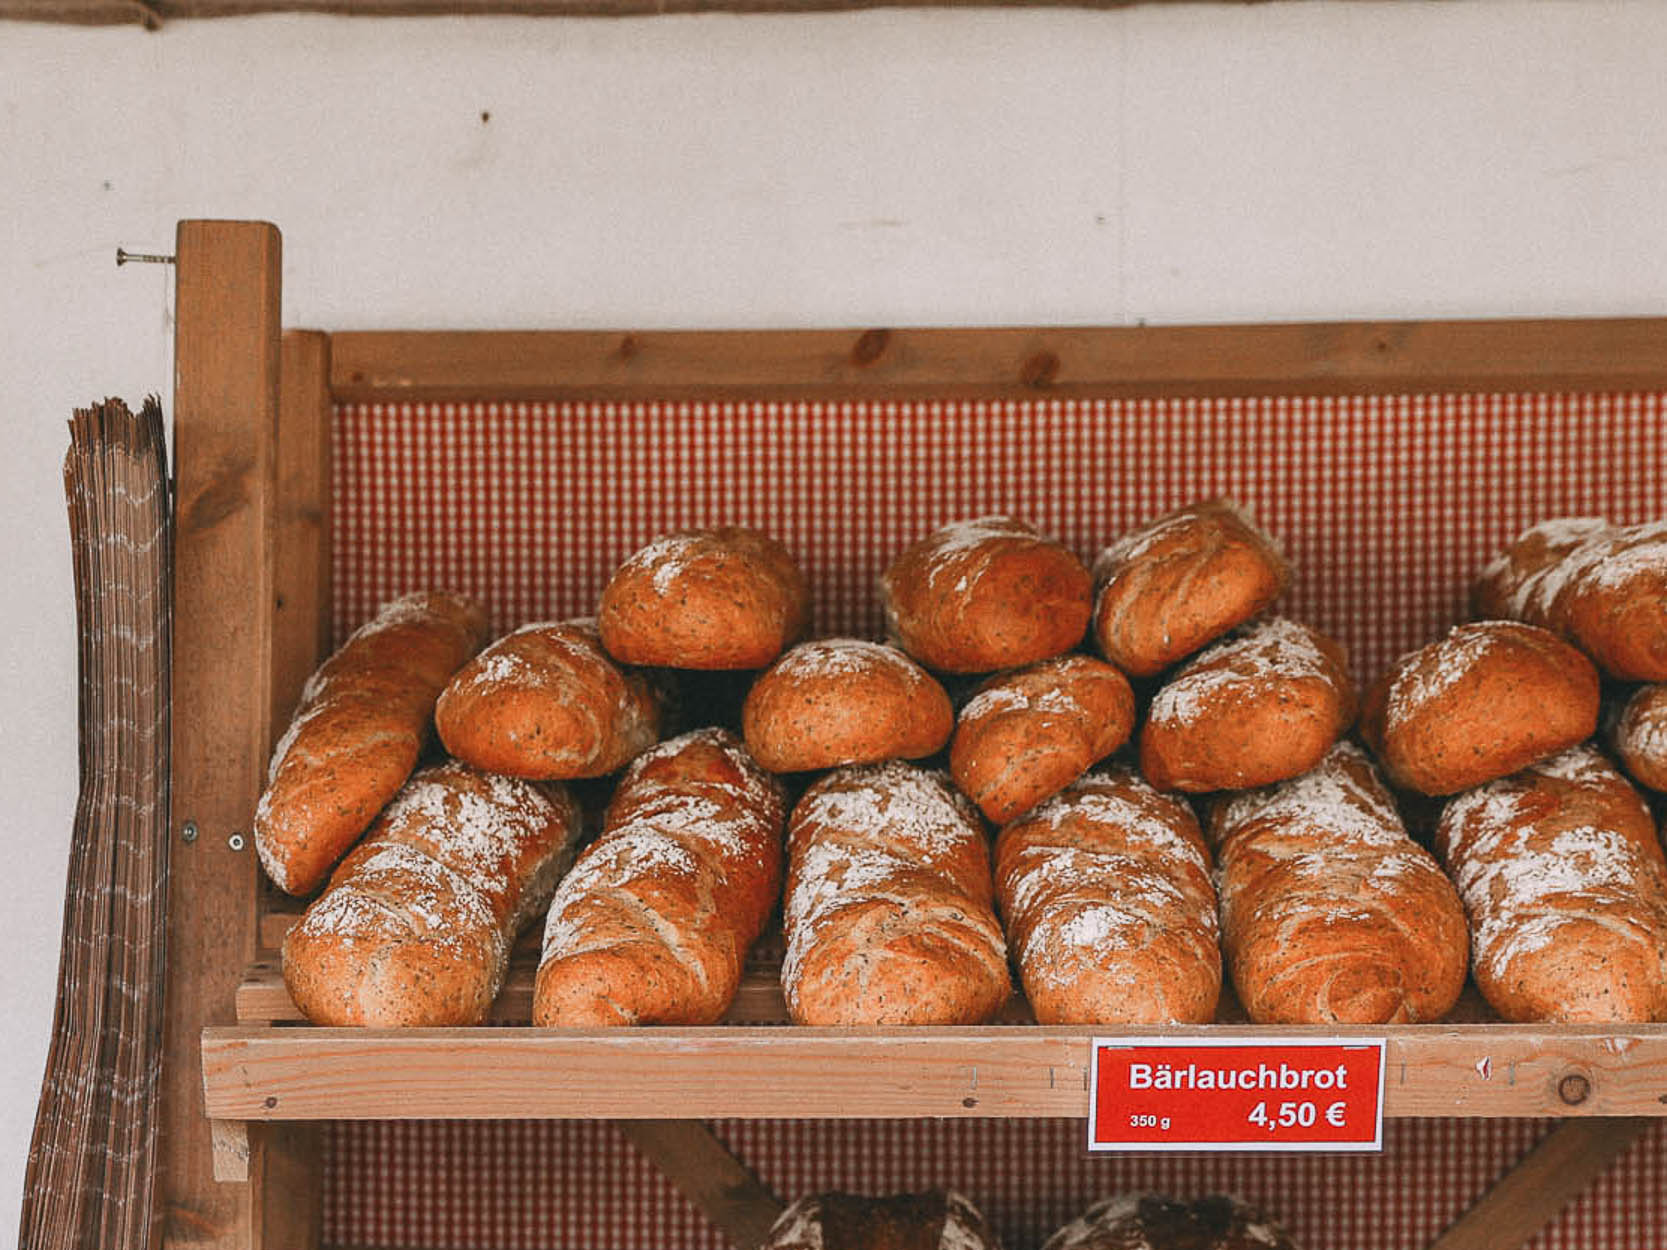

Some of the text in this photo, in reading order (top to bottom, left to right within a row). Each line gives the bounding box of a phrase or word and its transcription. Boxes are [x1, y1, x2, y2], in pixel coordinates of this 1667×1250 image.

[1130, 1064, 1347, 1089] Bärlauchbrot
[1131, 1115, 1170, 1129] 350 g
[1248, 1102, 1346, 1130] 4,50 €
